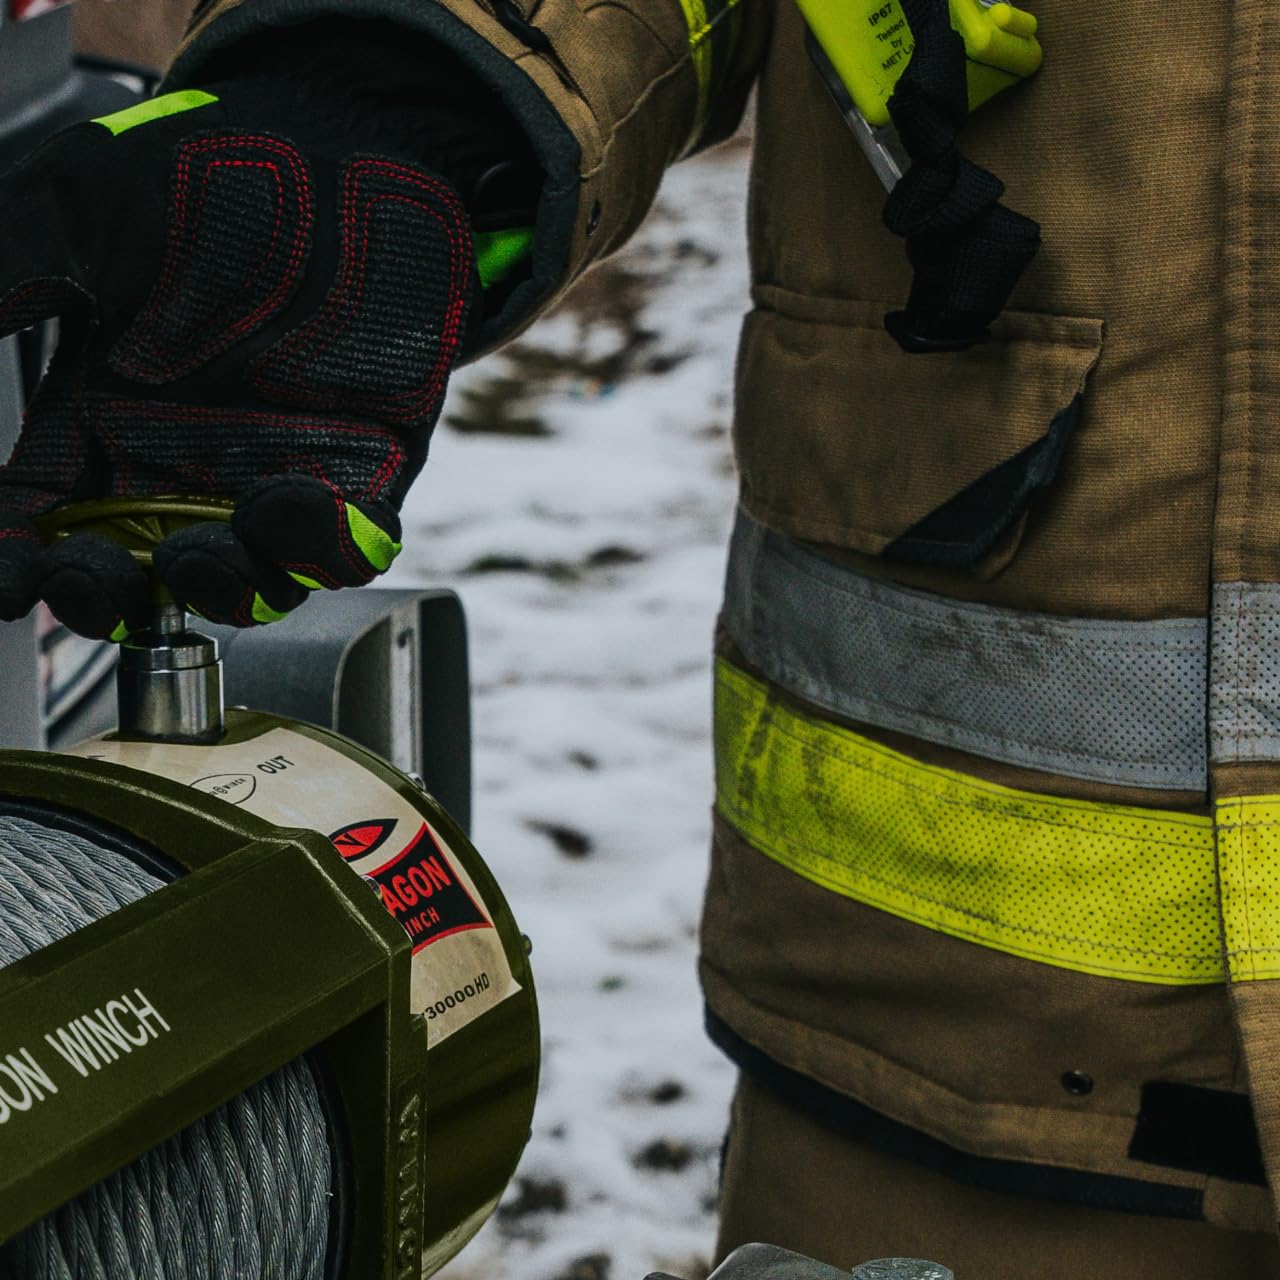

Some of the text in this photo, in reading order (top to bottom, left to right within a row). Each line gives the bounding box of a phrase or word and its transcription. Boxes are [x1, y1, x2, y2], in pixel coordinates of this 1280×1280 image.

[868, 3, 892, 26] IP67
[876, 18, 905, 42] Tested
[891, 37, 903, 48] by
[882, 51, 902, 71] MET
[256, 755, 295, 774] OUT
[379, 855, 452, 918] AGON
[405, 906, 440, 937] INCH
[44, 988, 171, 1078] WINCH
